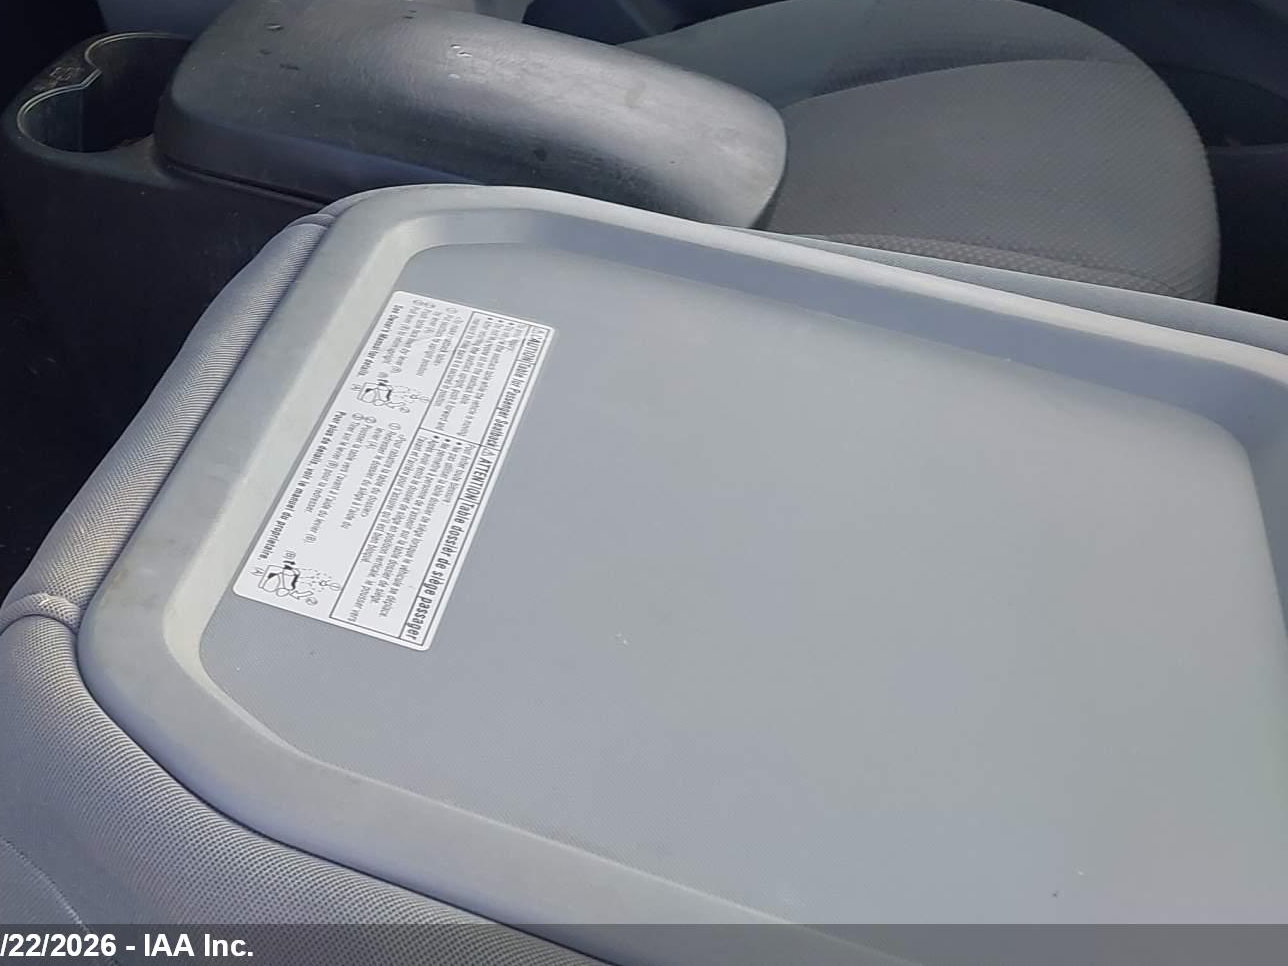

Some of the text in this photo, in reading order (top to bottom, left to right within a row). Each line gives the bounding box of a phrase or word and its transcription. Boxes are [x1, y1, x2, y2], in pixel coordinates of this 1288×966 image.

[514, 362, 530, 378] Table
[497, 387, 520, 419] Passenger
[485, 418, 507, 447] Seatback
[463, 457, 492, 500] ATTENTION
[453, 502, 474, 524] Table
[422, 570, 446, 596] siège
[405, 595, 433, 640] passager
